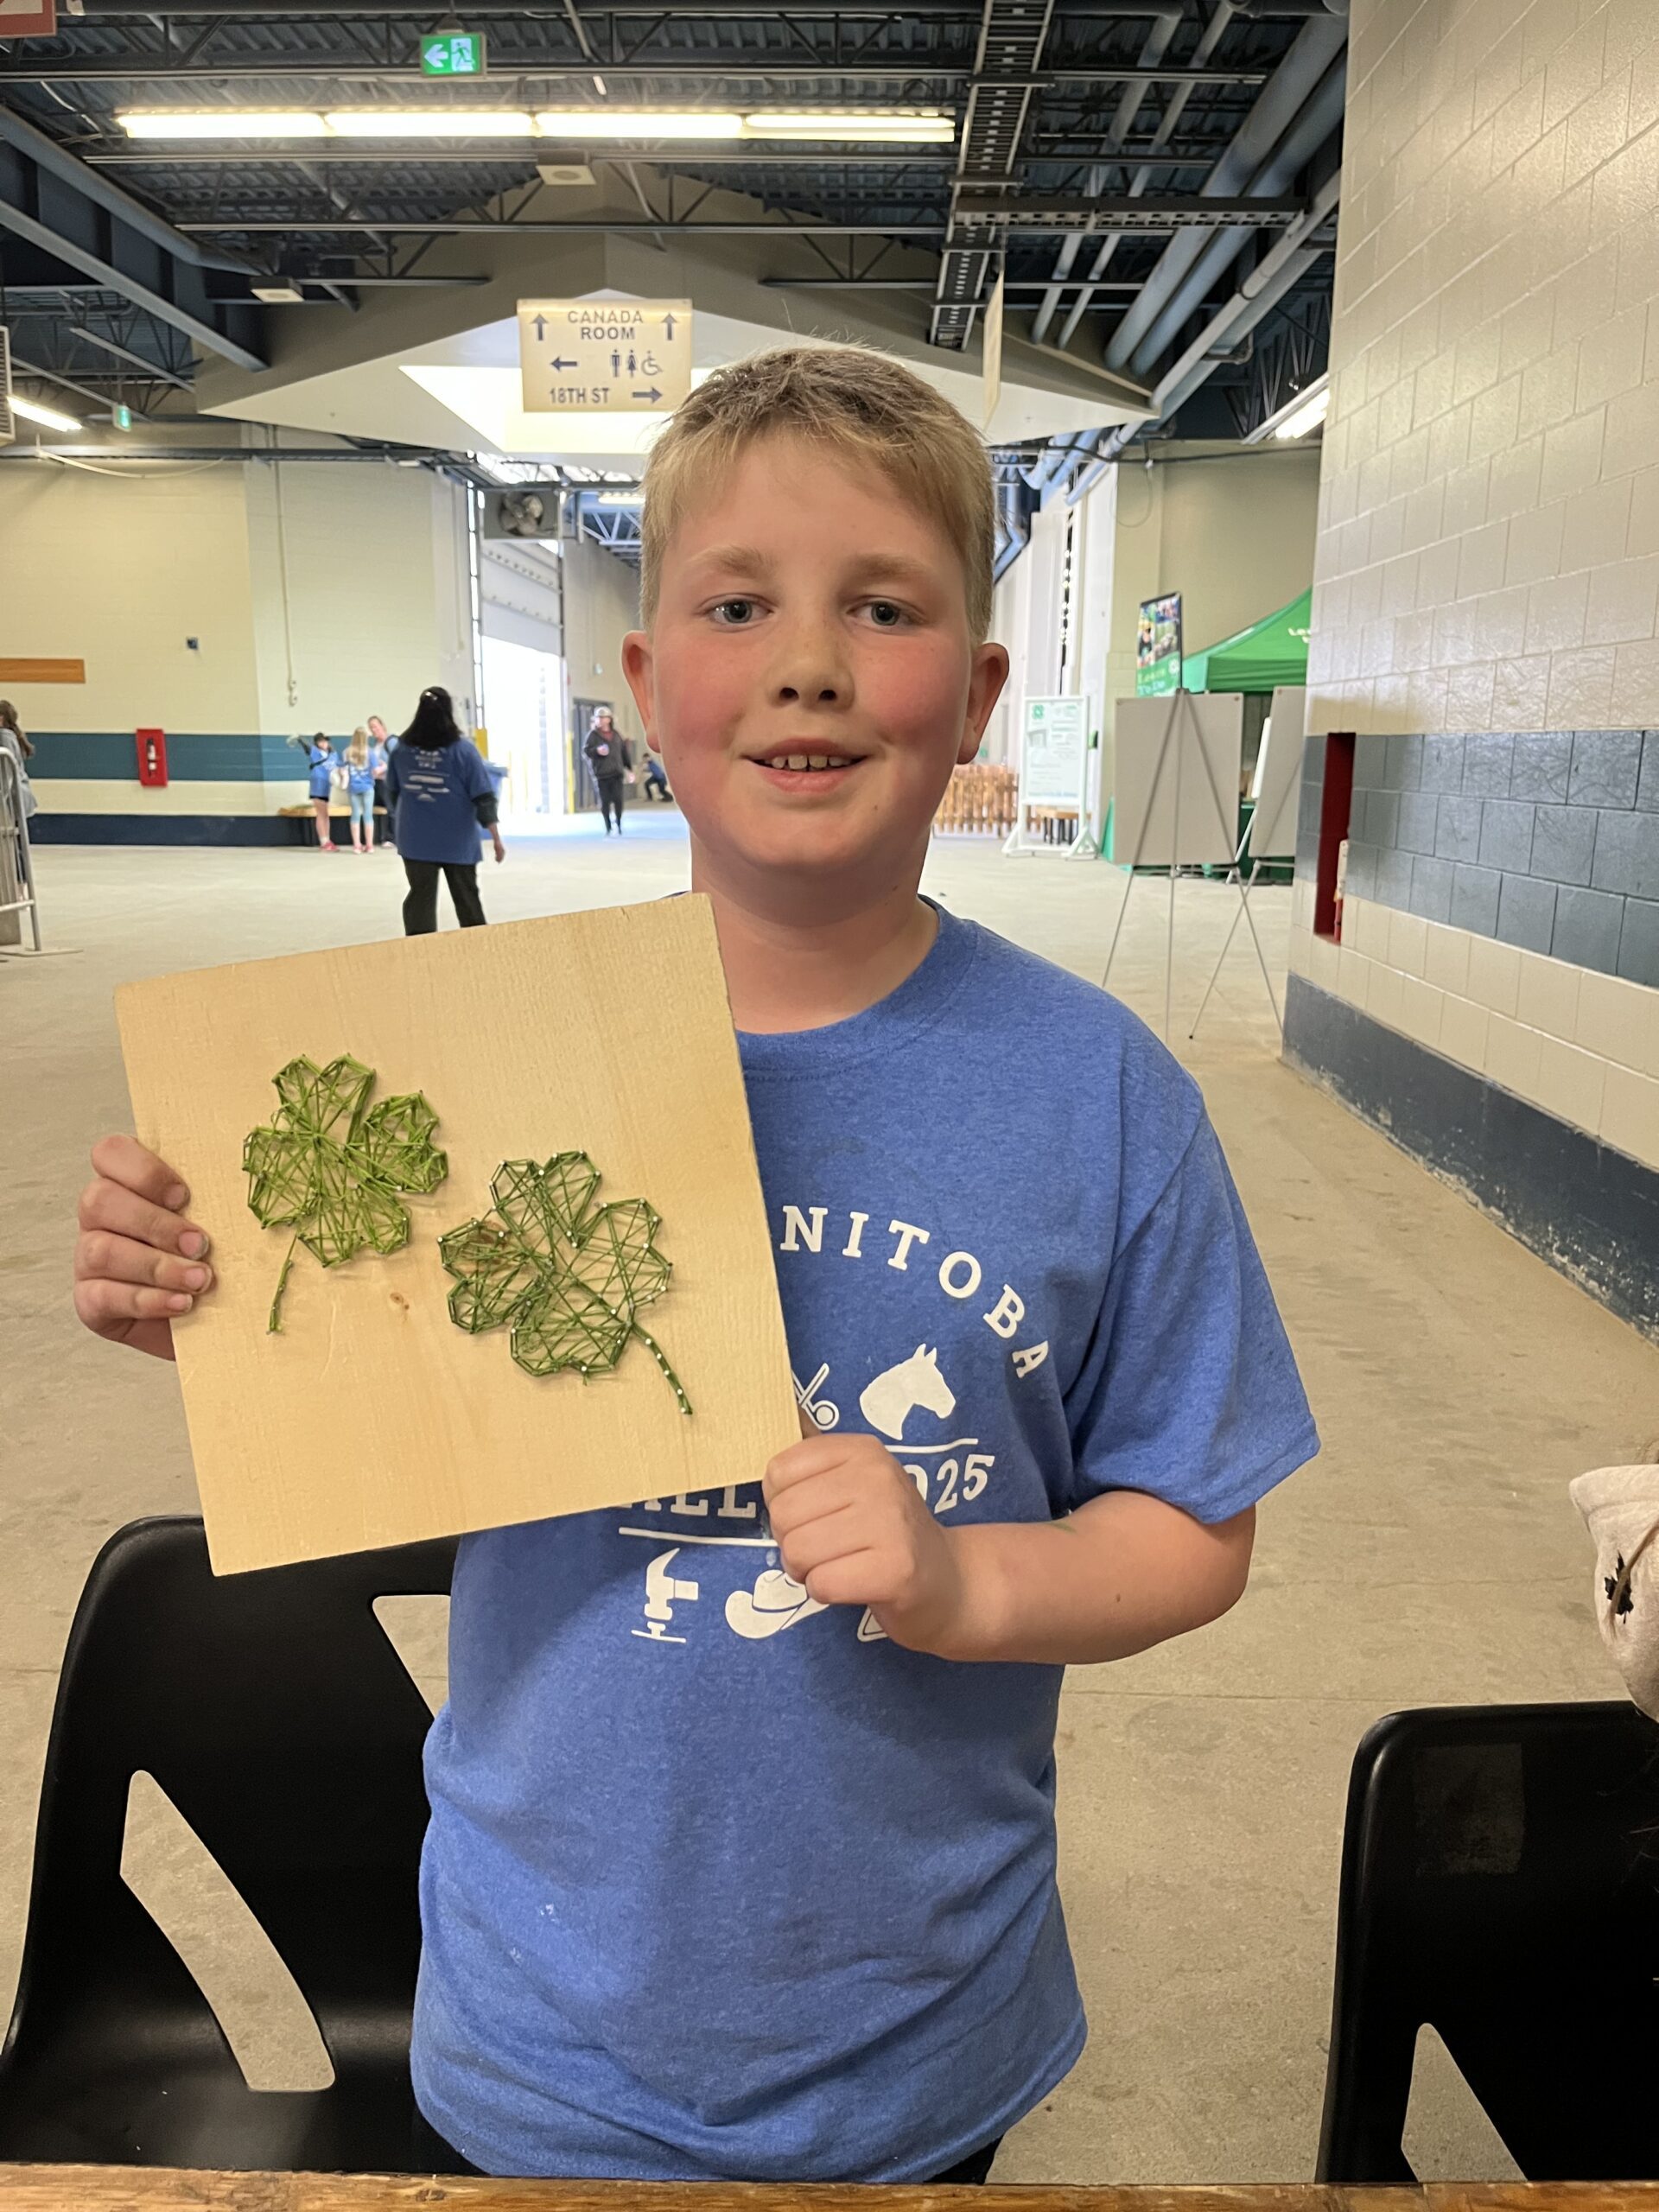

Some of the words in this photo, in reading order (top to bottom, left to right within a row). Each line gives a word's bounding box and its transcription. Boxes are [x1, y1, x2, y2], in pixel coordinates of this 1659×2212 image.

[567, 310, 644, 324] CANADA
[580, 327, 636, 340] ROOM
[550, 387, 588, 404] 18TH
[591, 387, 610, 404] ST
[614, 1484, 757, 1519] LL
